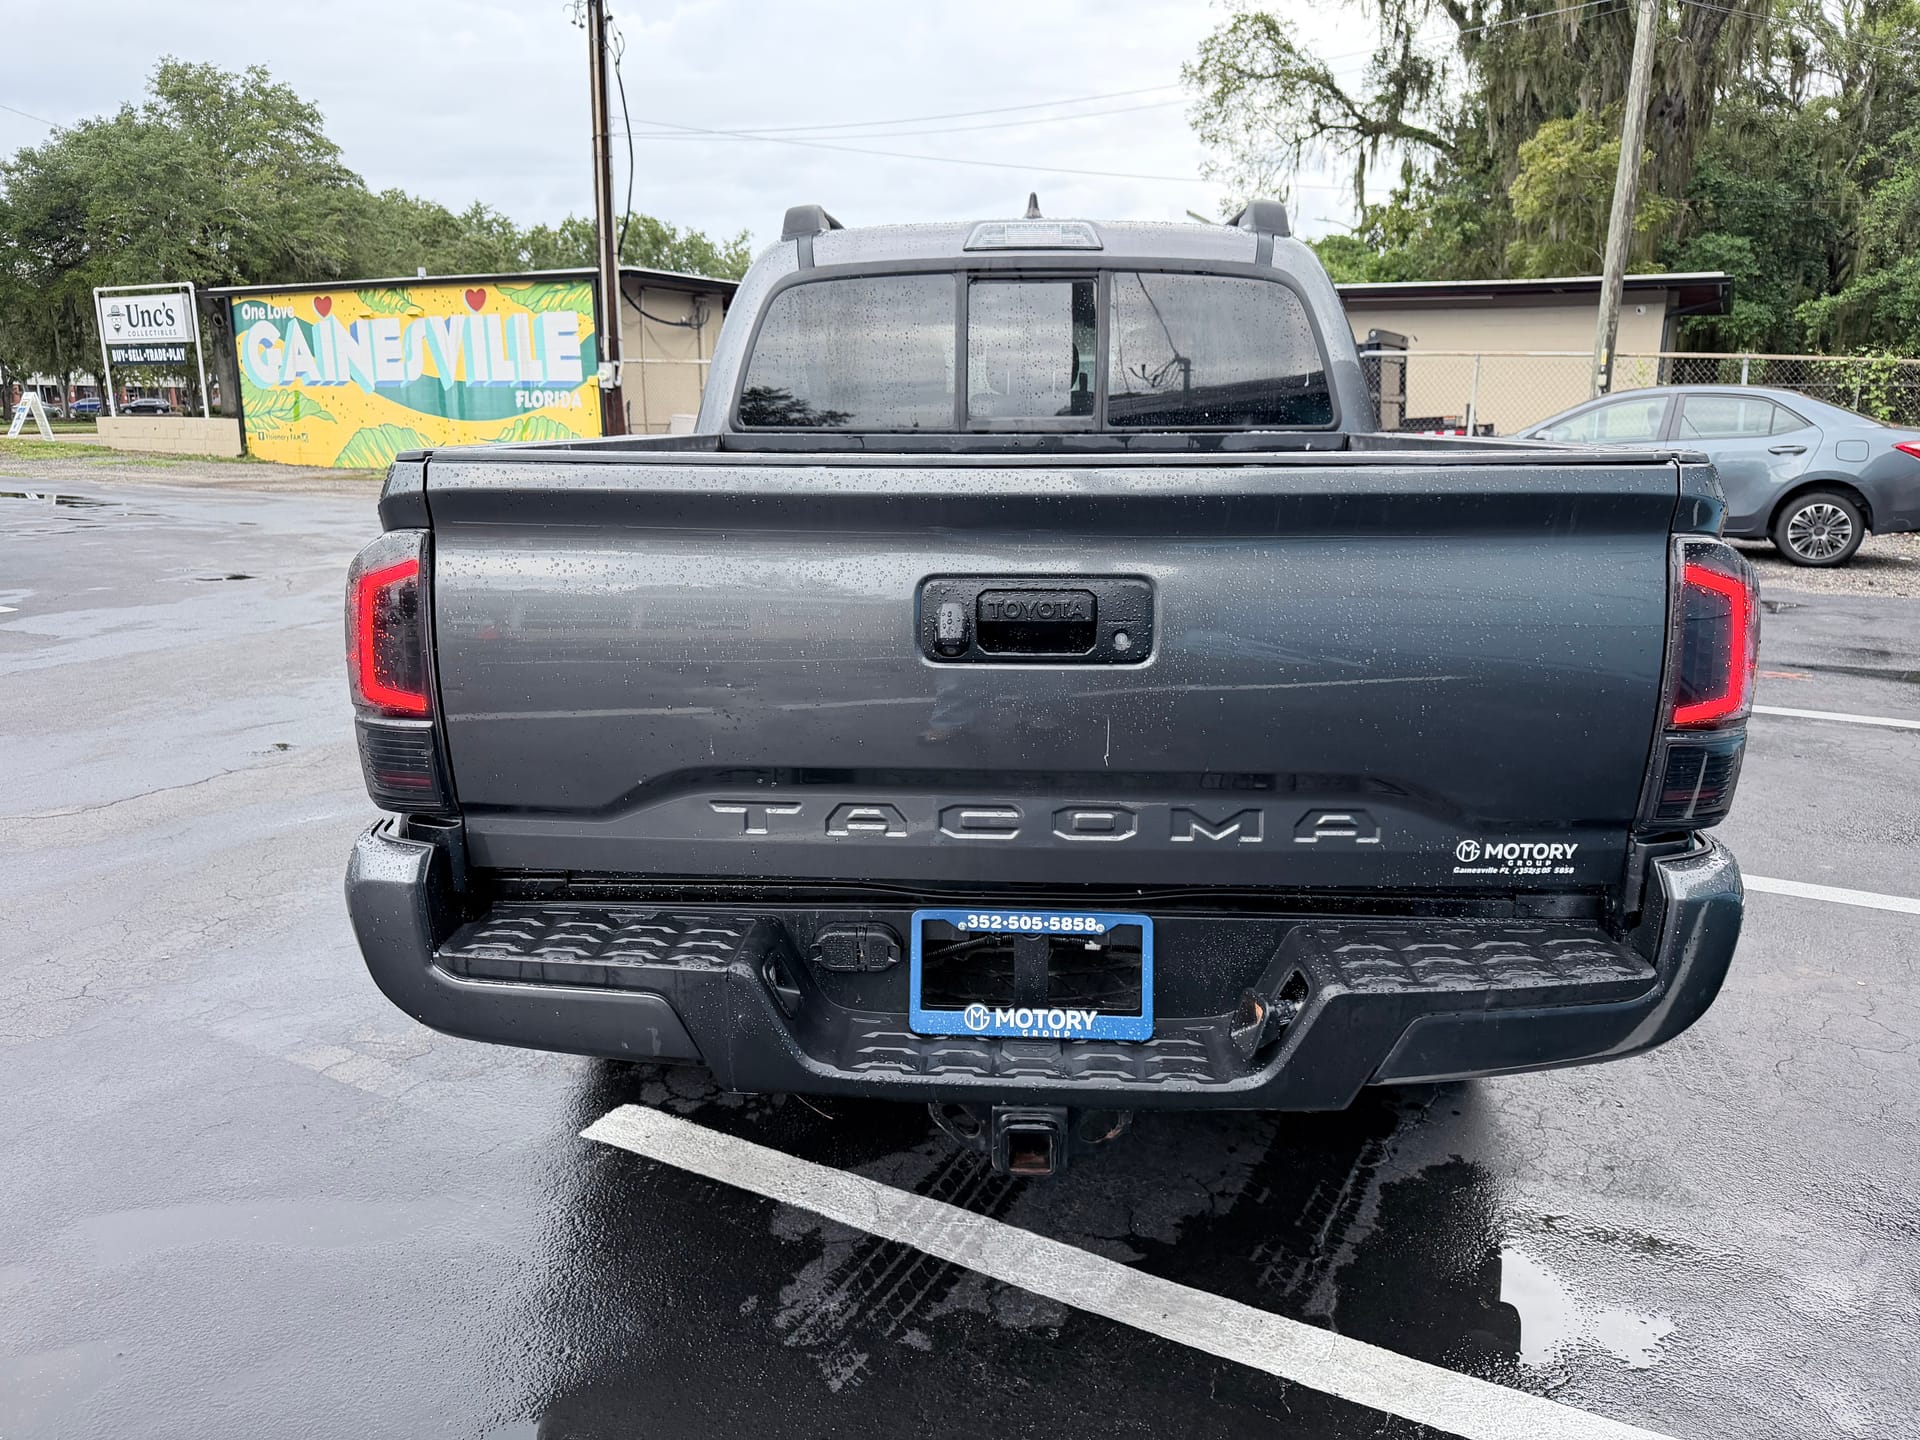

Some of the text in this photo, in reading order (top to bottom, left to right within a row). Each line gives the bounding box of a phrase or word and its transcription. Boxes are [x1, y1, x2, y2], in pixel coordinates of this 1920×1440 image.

[125, 302, 175, 328] Unc's
[242, 303, 295, 320] One Love
[127, 329, 177, 337] COLLECTIBLES
[243, 311, 583, 394] GAINESVILLE
[515, 390, 582, 409] FLORIDA
[988, 600, 1086, 620] TOYOTA
[708, 800, 1382, 844] TACOMA
[1484, 843, 1579, 860] MOTORY
[995, 1007, 1098, 1031] MOTORY
[1021, 1029, 1071, 1039] GROUP
